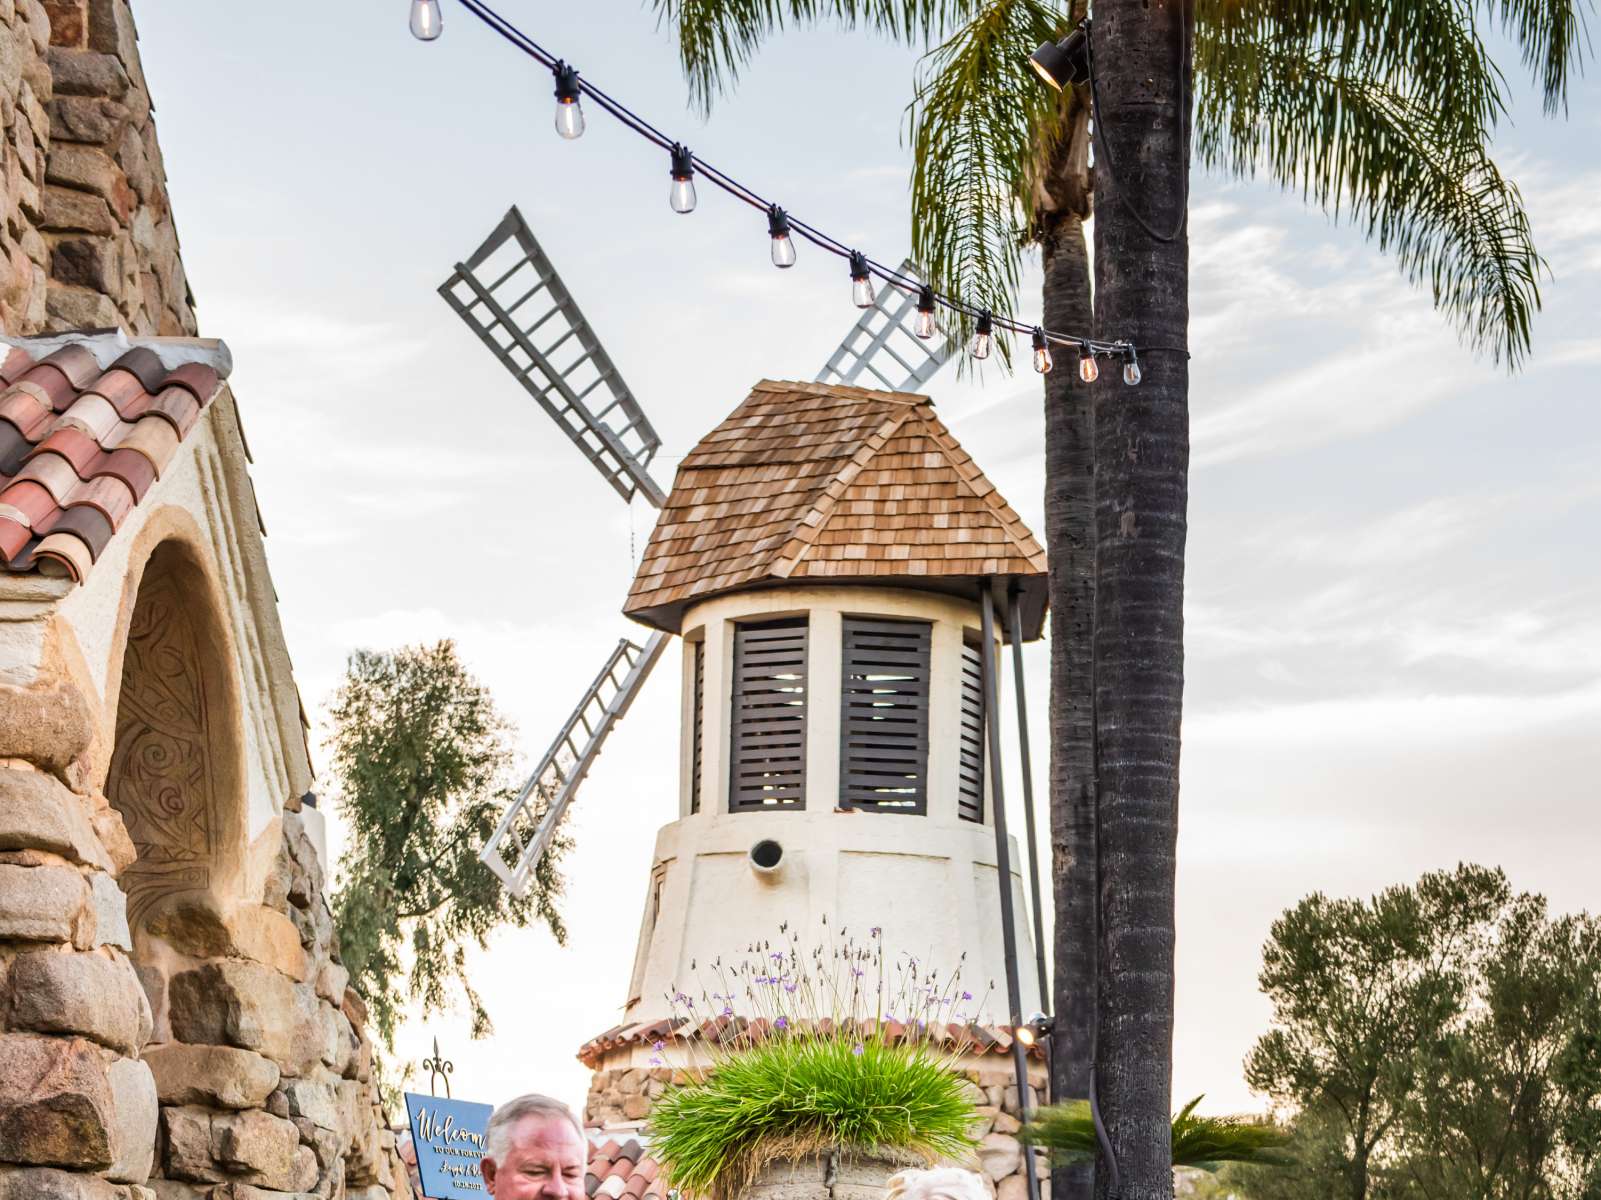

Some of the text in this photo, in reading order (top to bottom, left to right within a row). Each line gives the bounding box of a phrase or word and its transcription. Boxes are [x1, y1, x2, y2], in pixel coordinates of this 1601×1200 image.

[415, 1106, 487, 1150] Welcom
[433, 1145, 486, 1158] TO OUR FOREVE
